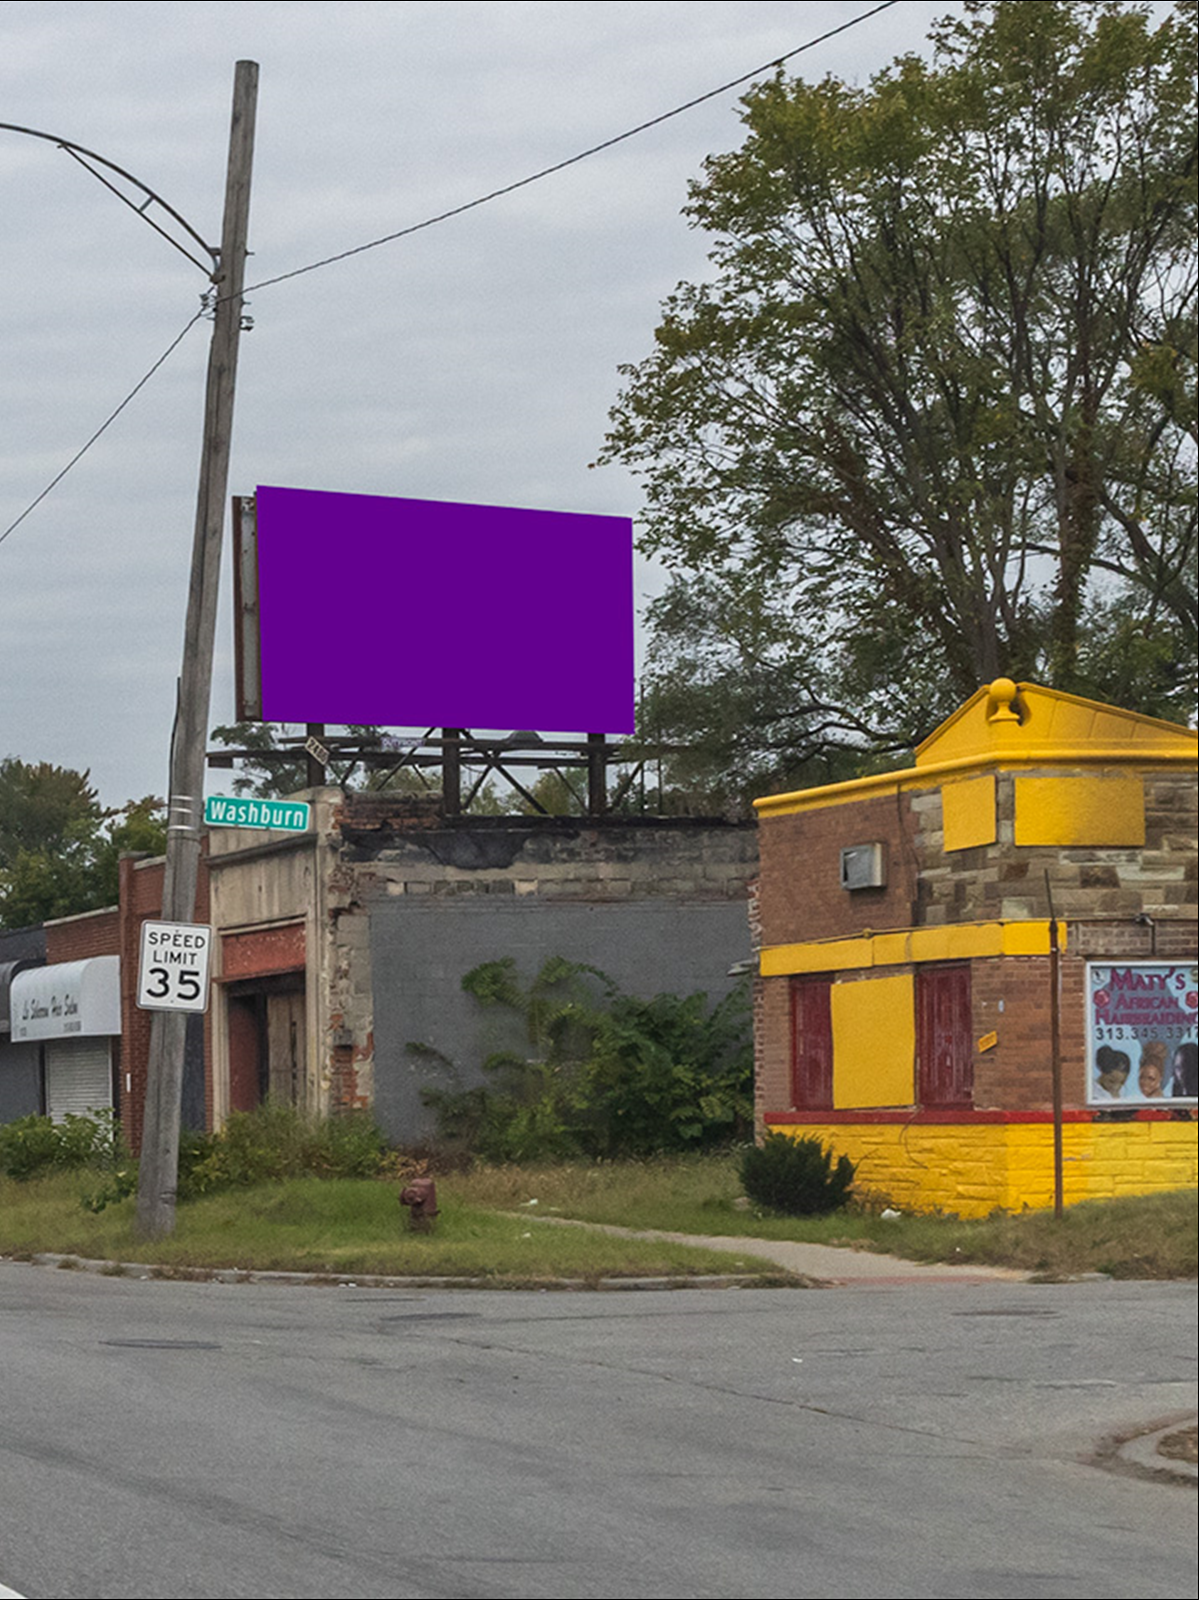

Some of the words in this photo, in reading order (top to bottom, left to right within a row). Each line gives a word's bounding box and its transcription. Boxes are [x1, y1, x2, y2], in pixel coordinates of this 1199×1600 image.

[211, 800, 304, 827] Washburn
[148, 931, 206, 949] SPEED
[153, 949, 198, 966] LIMIT
[146, 967, 201, 1001] 35
[1109, 966, 1186, 990] MATY'S
[1115, 992, 1179, 1010] AFRICAN
